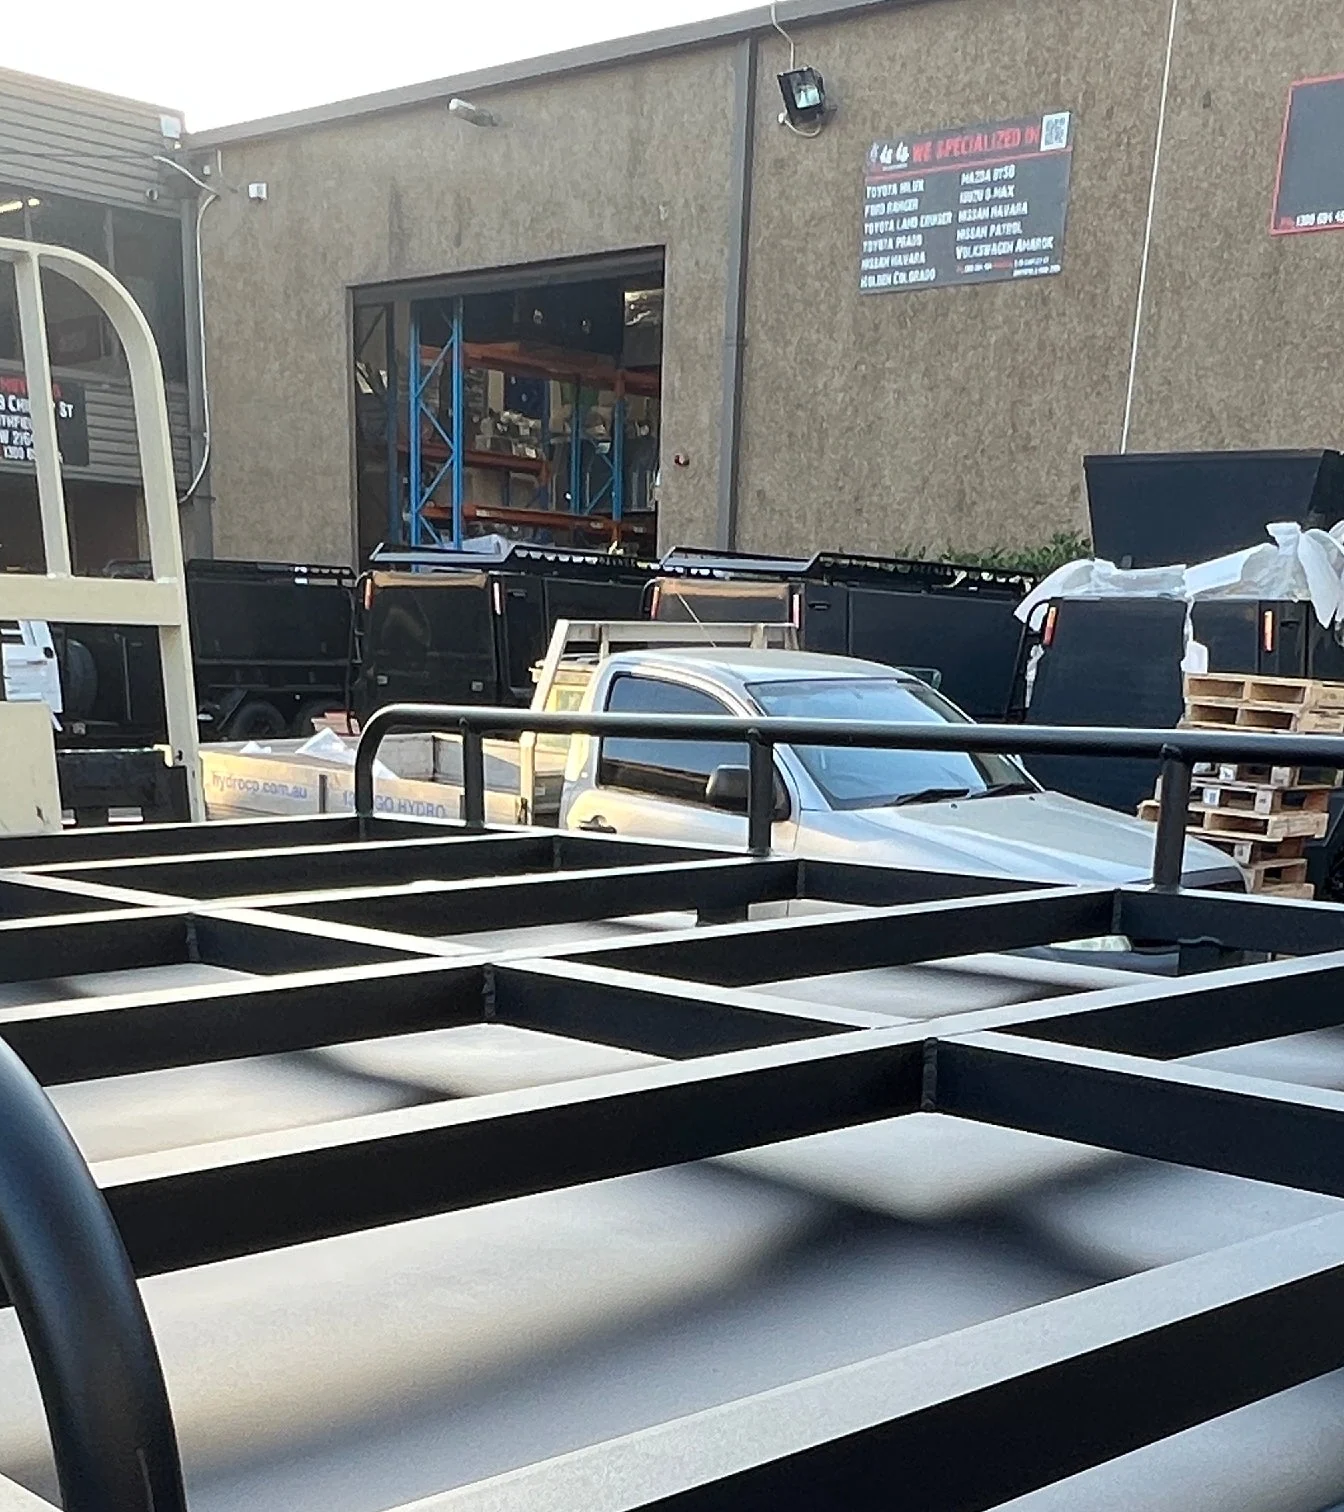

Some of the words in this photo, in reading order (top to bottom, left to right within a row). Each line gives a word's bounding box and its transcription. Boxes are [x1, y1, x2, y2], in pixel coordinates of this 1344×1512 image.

[961, 169, 991, 185] MAZDA
[866, 183, 897, 199] TOYOTA
[958, 206, 989, 223] NISSAN
[990, 201, 1028, 219] NAVARA
[864, 219, 895, 235] TOYOTA
[896, 216, 918, 231] LAND
[920, 210, 952, 228] CRUISER
[956, 225, 988, 241] NISSAN
[989, 221, 1023, 238] PATROL
[863, 238, 894, 253] TOYOTA
[895, 234, 923, 249] PRADO
[956, 241, 1014, 260] VOLKSWAGEN
[1015, 236, 1054, 253] AMAROK
[861, 255, 890, 270] NISSAN
[891, 251, 925, 266] NAVARA
[860, 273, 892, 288] HOLDEN
[893, 267, 936, 285] COLORADO
[59, 401, 73, 418] ST
[12, 430, 33, 446] 216
[398, 800, 445, 818] HYDRO
